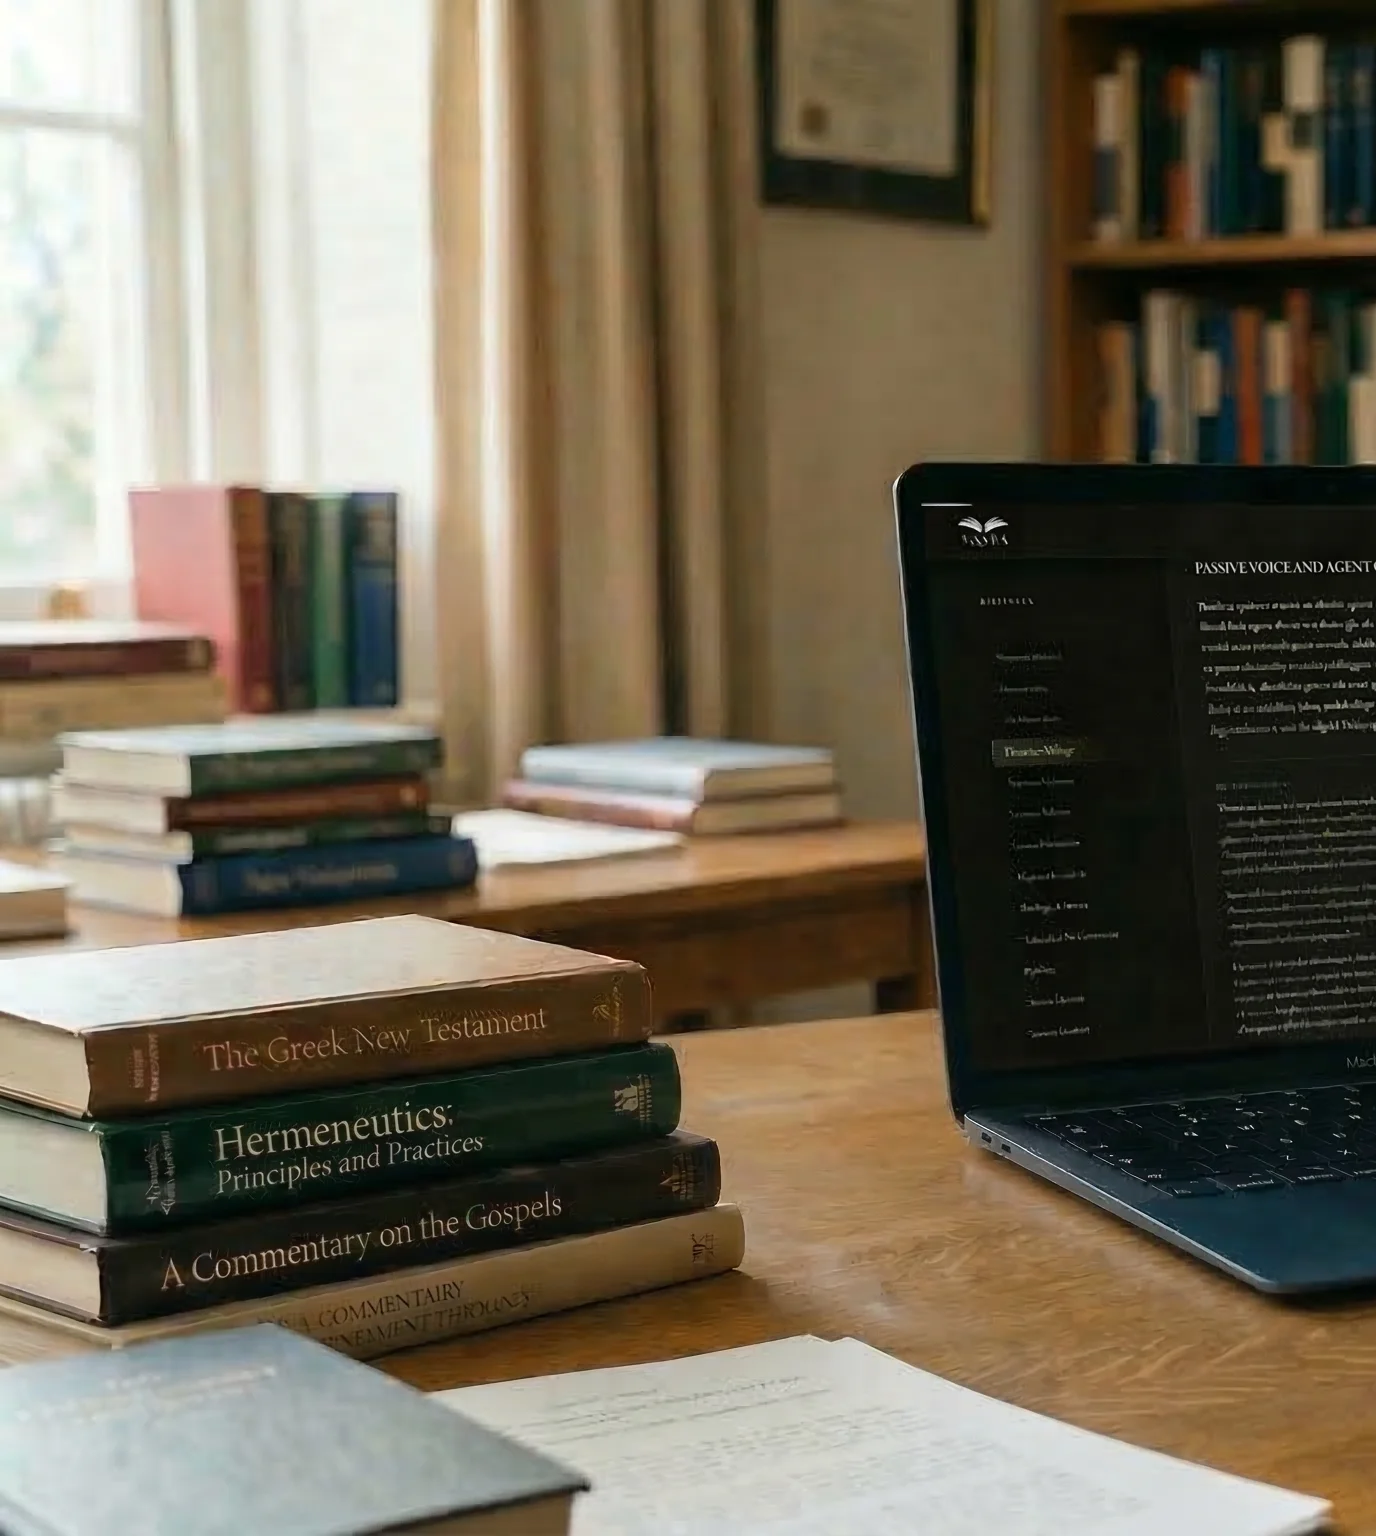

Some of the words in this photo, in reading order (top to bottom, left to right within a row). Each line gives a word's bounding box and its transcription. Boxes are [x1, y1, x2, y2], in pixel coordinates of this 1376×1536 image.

[1194, 561, 1248, 575] PASSIVE
[1249, 560, 1292, 574] VOICE
[1293, 560, 1324, 574] AND
[1326, 559, 1372, 573] AGENT
[203, 1041, 258, 1072] The
[268, 1028, 349, 1064] Greek
[352, 1025, 410, 1053] New
[420, 1007, 547, 1044] Testament
[215, 1101, 454, 1162] Hermeneutics:
[216, 1157, 332, 1194] Principles
[338, 1144, 380, 1174] and
[386, 1134, 484, 1166] Practices
[161, 1256, 186, 1292] A
[191, 1231, 372, 1283] Commentary
[379, 1223, 413, 1248] on
[418, 1210, 460, 1241] the
[465, 1190, 562, 1231] Gospels
